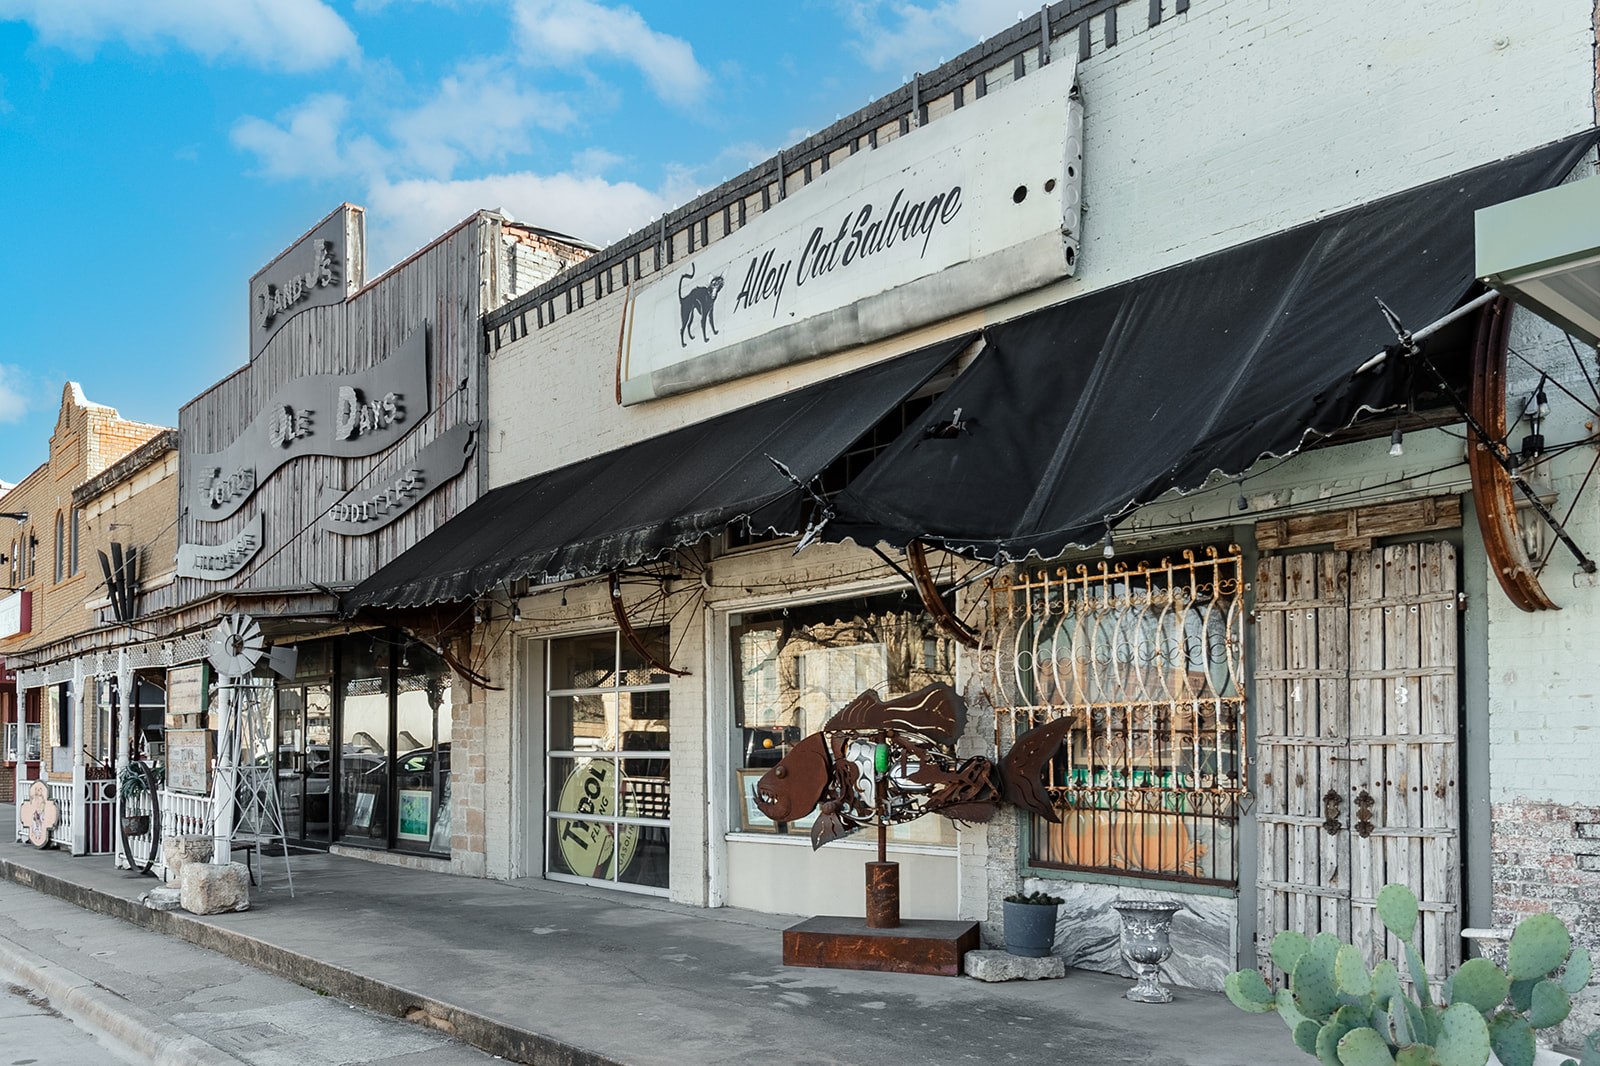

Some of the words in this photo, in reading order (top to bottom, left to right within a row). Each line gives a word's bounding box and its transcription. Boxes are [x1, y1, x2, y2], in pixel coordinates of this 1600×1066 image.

[733, 248, 792, 318] Alley
[796, 212, 853, 287] Cat
[841, 186, 963, 267] Salvage
[590, 795, 609, 843] FLYNG
